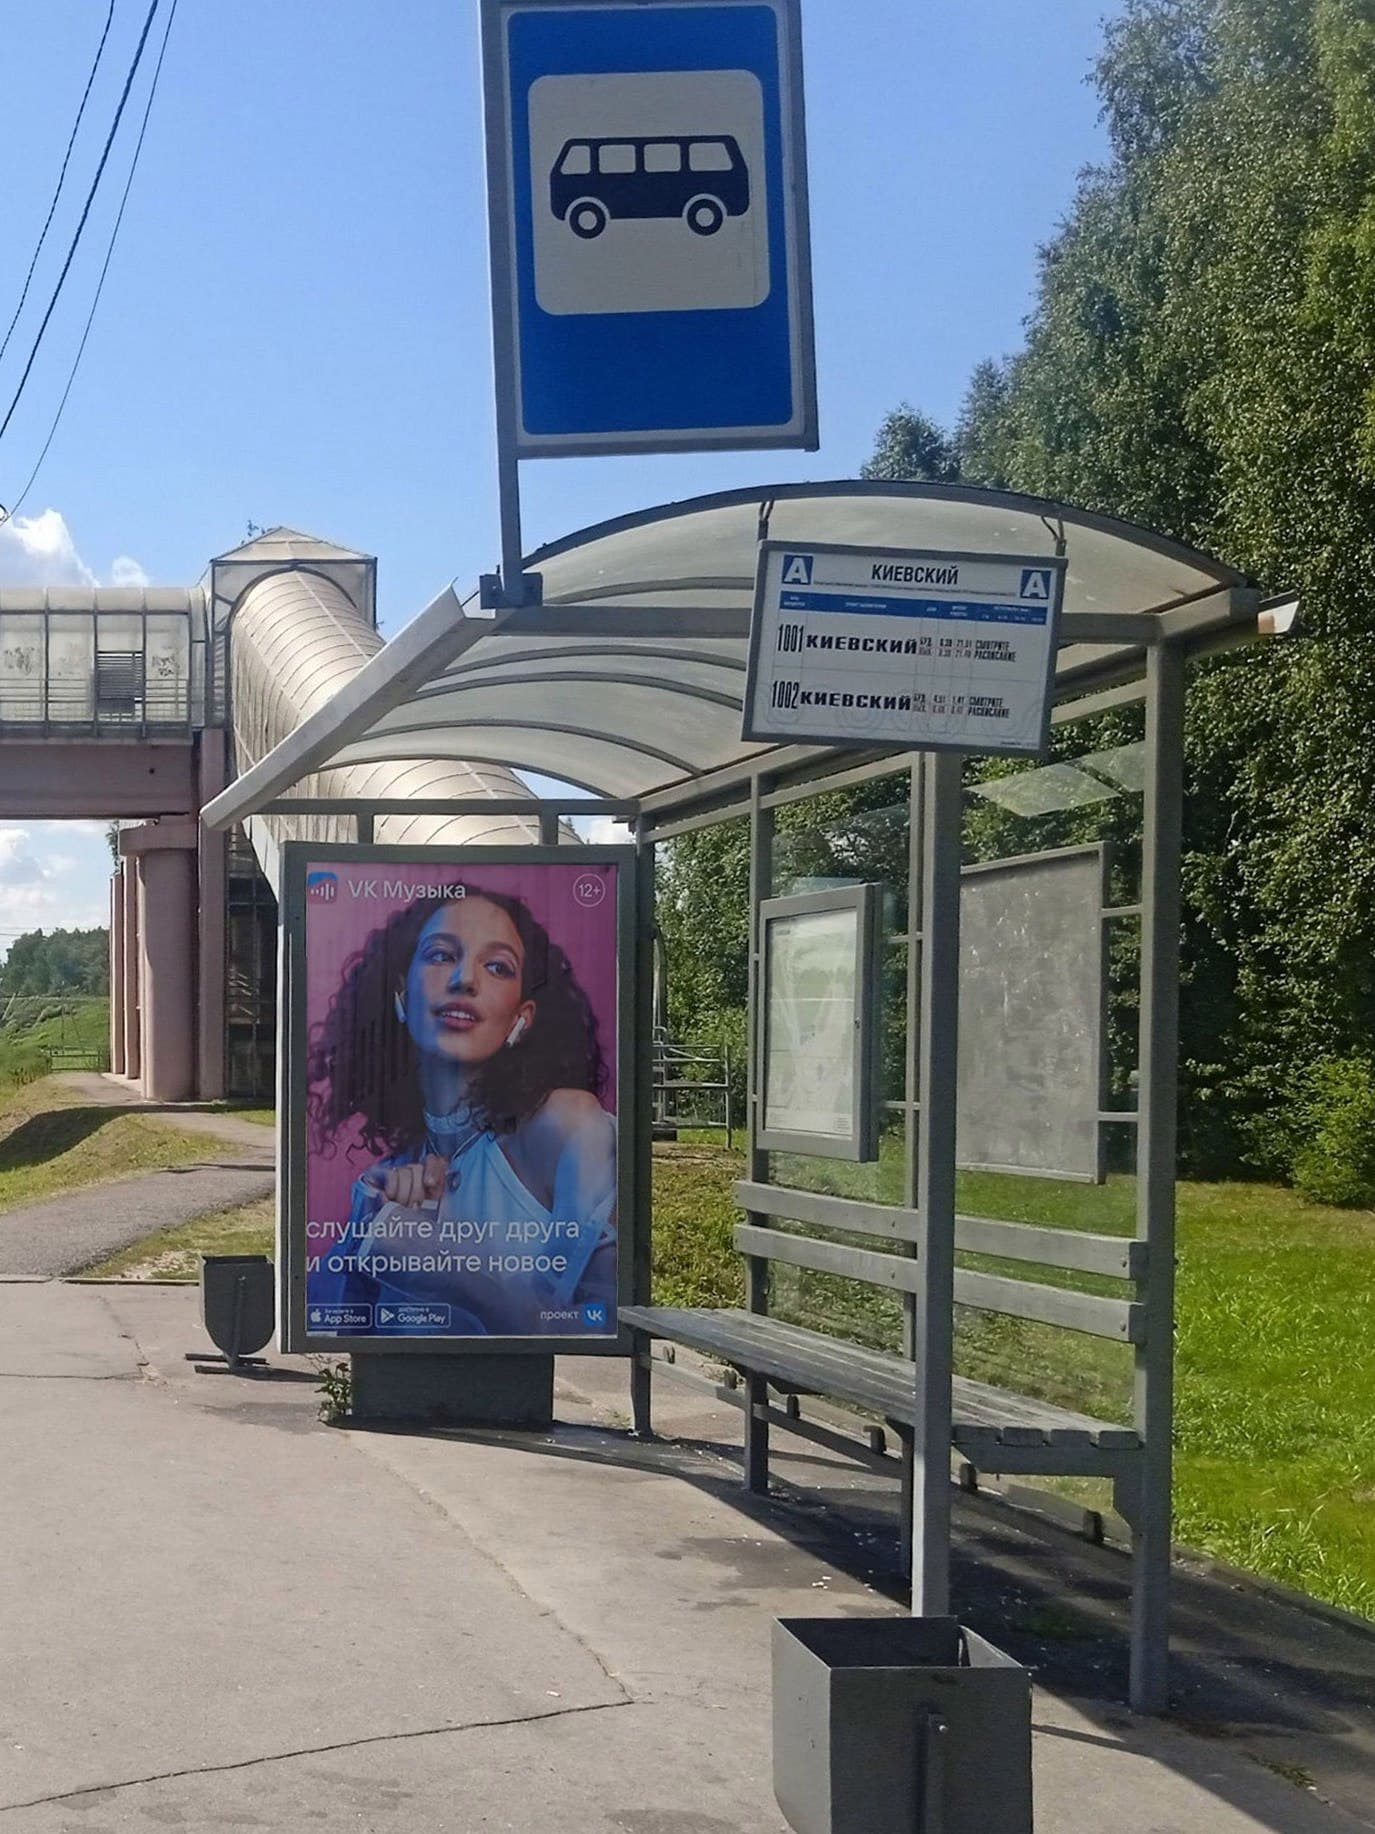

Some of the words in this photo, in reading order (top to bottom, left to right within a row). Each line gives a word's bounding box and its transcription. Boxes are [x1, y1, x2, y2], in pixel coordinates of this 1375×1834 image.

[783, 556, 809, 584] А
[871, 563, 959, 585] КИЕВСКИЙ
[1021, 571, 1048, 599] А
[777, 624, 805, 653] 1001
[805, 633, 917, 655] КИЕВСКИЙ
[771, 680, 800, 710] 1002
[800, 690, 911, 712] КИЕВСКИЙ
[347, 879, 378, 898] VK
[383, 879, 467, 903] Музыка
[578, 883, 602, 898] 12+
[305, 1215, 433, 1244] слушайте
[439, 1220, 499, 1244] друг
[505, 1220, 580, 1244] друга
[306, 1255, 321, 1273] и
[327, 1249, 482, 1278] открывайте
[488, 1255, 568, 1273] новое
[324, 1314, 343, 1324] App
[343, 1313, 367, 1323] Store
[396, 1313, 428, 1325] Google
[428, 1312, 446, 1325] Play
[539, 1310, 580, 1321] проект
